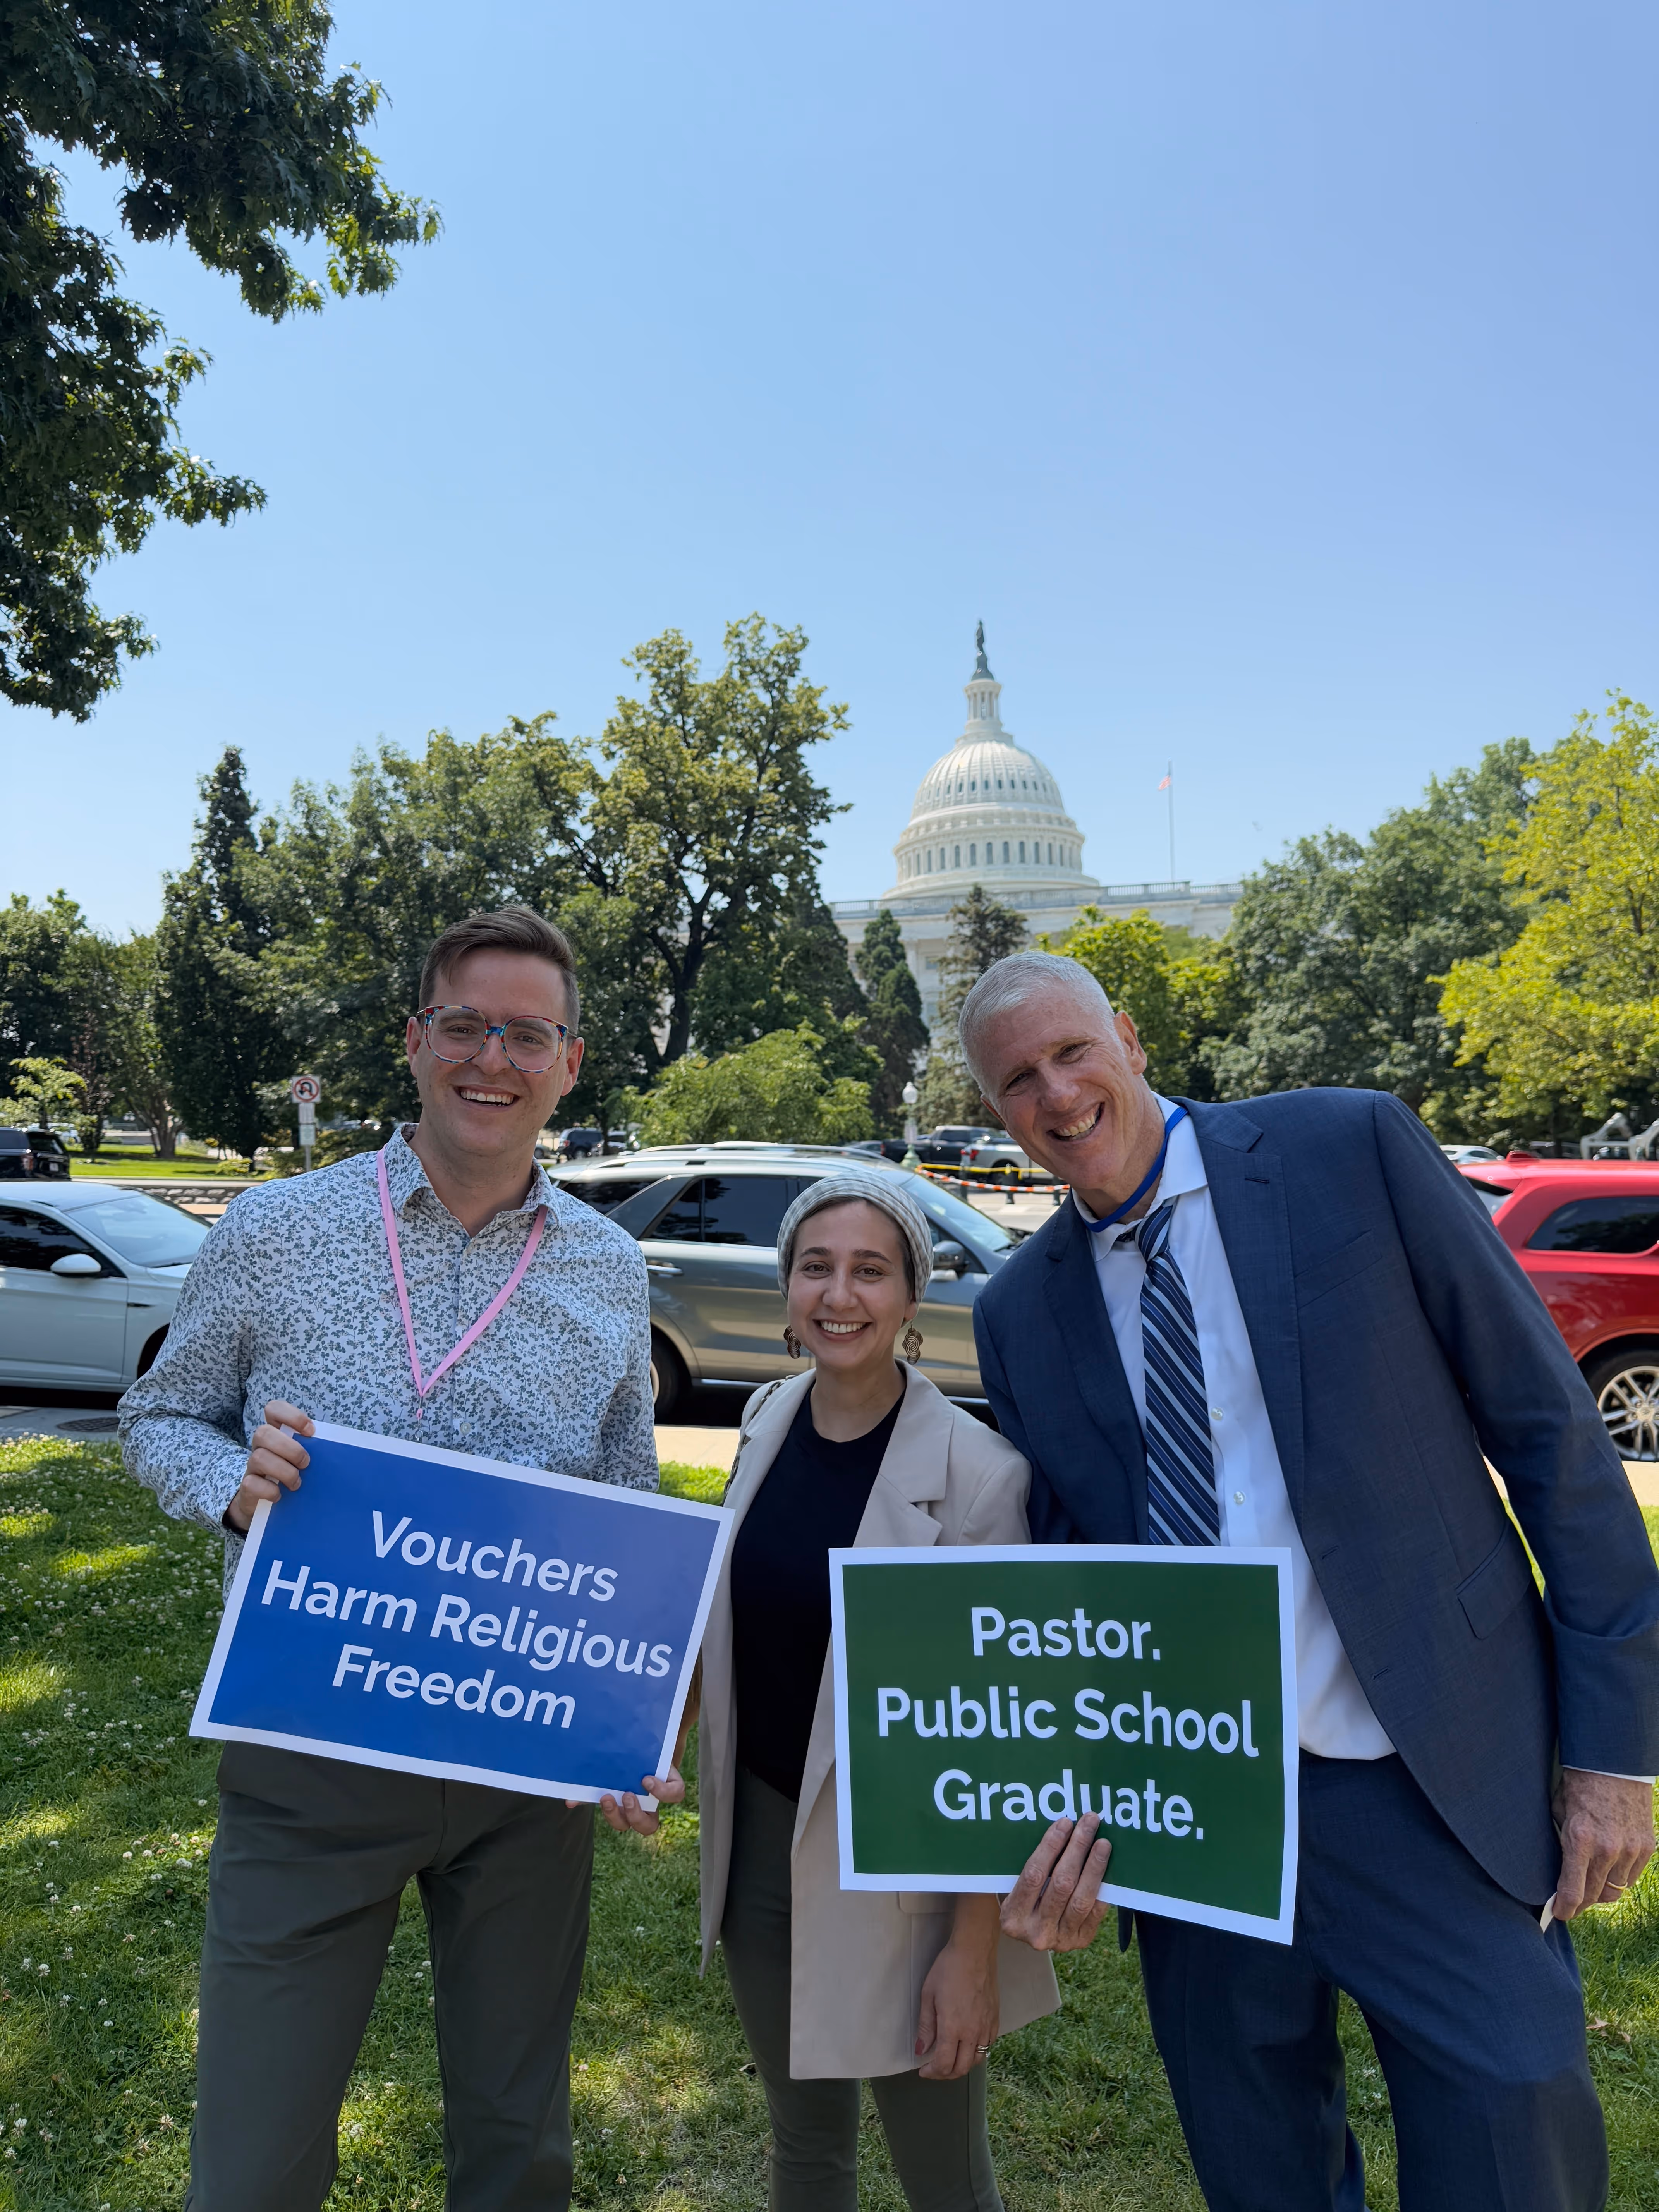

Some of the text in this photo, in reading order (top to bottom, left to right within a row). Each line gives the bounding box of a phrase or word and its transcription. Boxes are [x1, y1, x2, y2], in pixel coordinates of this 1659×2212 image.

[372, 1510, 618, 1601] Vouchers
[261, 1560, 673, 1677] Harm Religious
[971, 1607, 1161, 1660] Pastor.
[332, 1644, 575, 1729] Freedom
[878, 1686, 1259, 1757] Public School
[934, 1769, 1204, 1840] Graduate.
